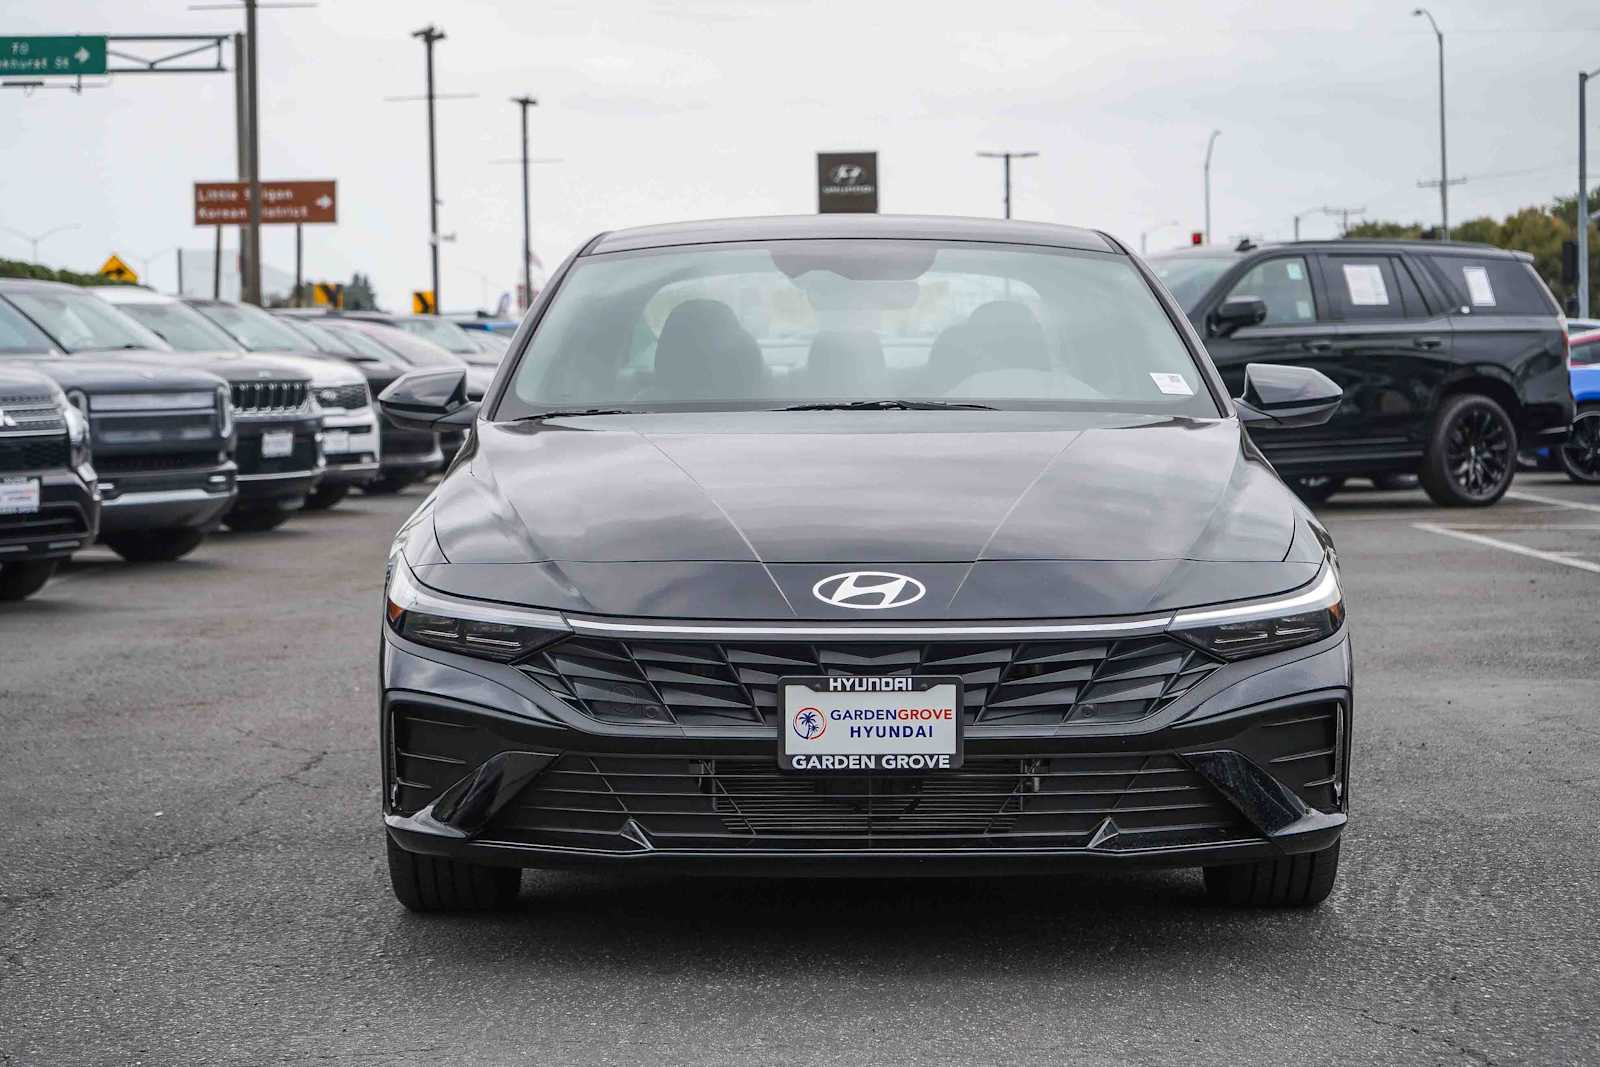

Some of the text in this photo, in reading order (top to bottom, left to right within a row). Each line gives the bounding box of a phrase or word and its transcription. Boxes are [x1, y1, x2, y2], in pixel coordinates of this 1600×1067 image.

[260, 205, 308, 218] istrict
[829, 677, 912, 691] HYUNDAI
[850, 725, 933, 738] HYUNDAI
[792, 755, 950, 769] GARDEN GROVE
